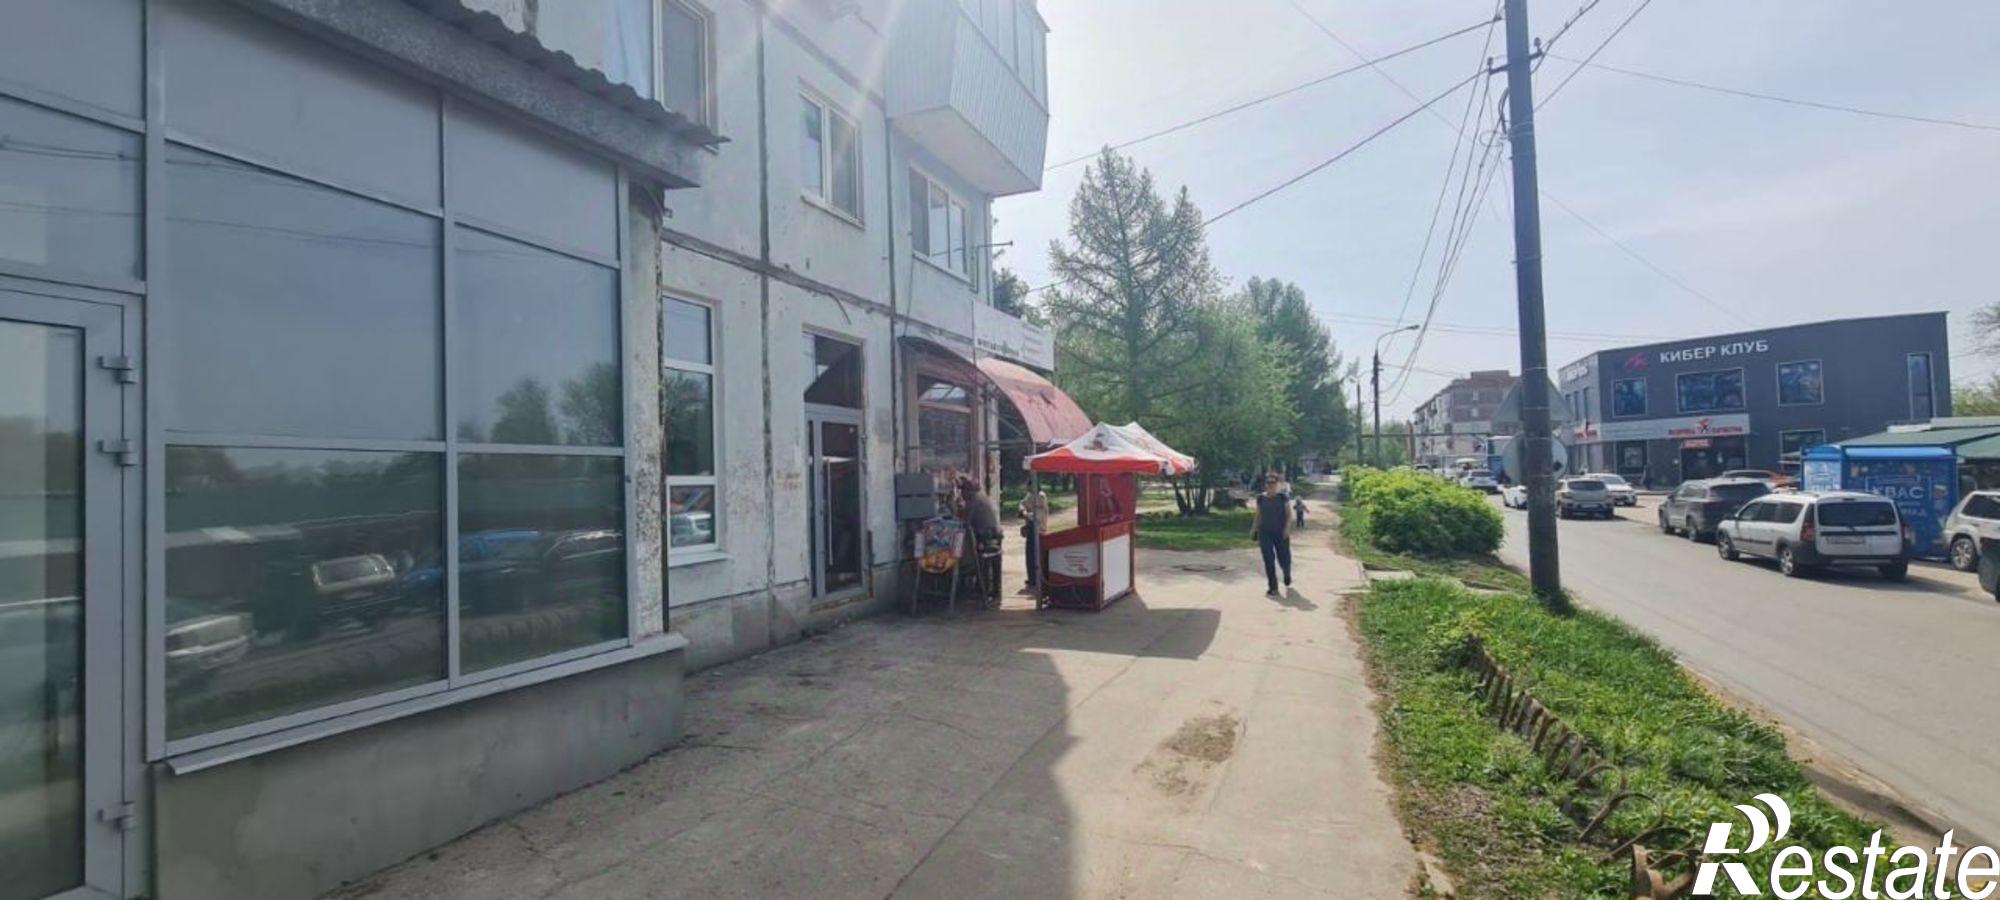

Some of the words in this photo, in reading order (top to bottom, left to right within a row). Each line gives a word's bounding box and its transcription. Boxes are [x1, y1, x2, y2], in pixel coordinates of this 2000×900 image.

[1660, 346, 1717, 363] КИБЕР
[1720, 339, 1769, 356] КЛУБ
[1872, 485, 1925, 500] КВАС
